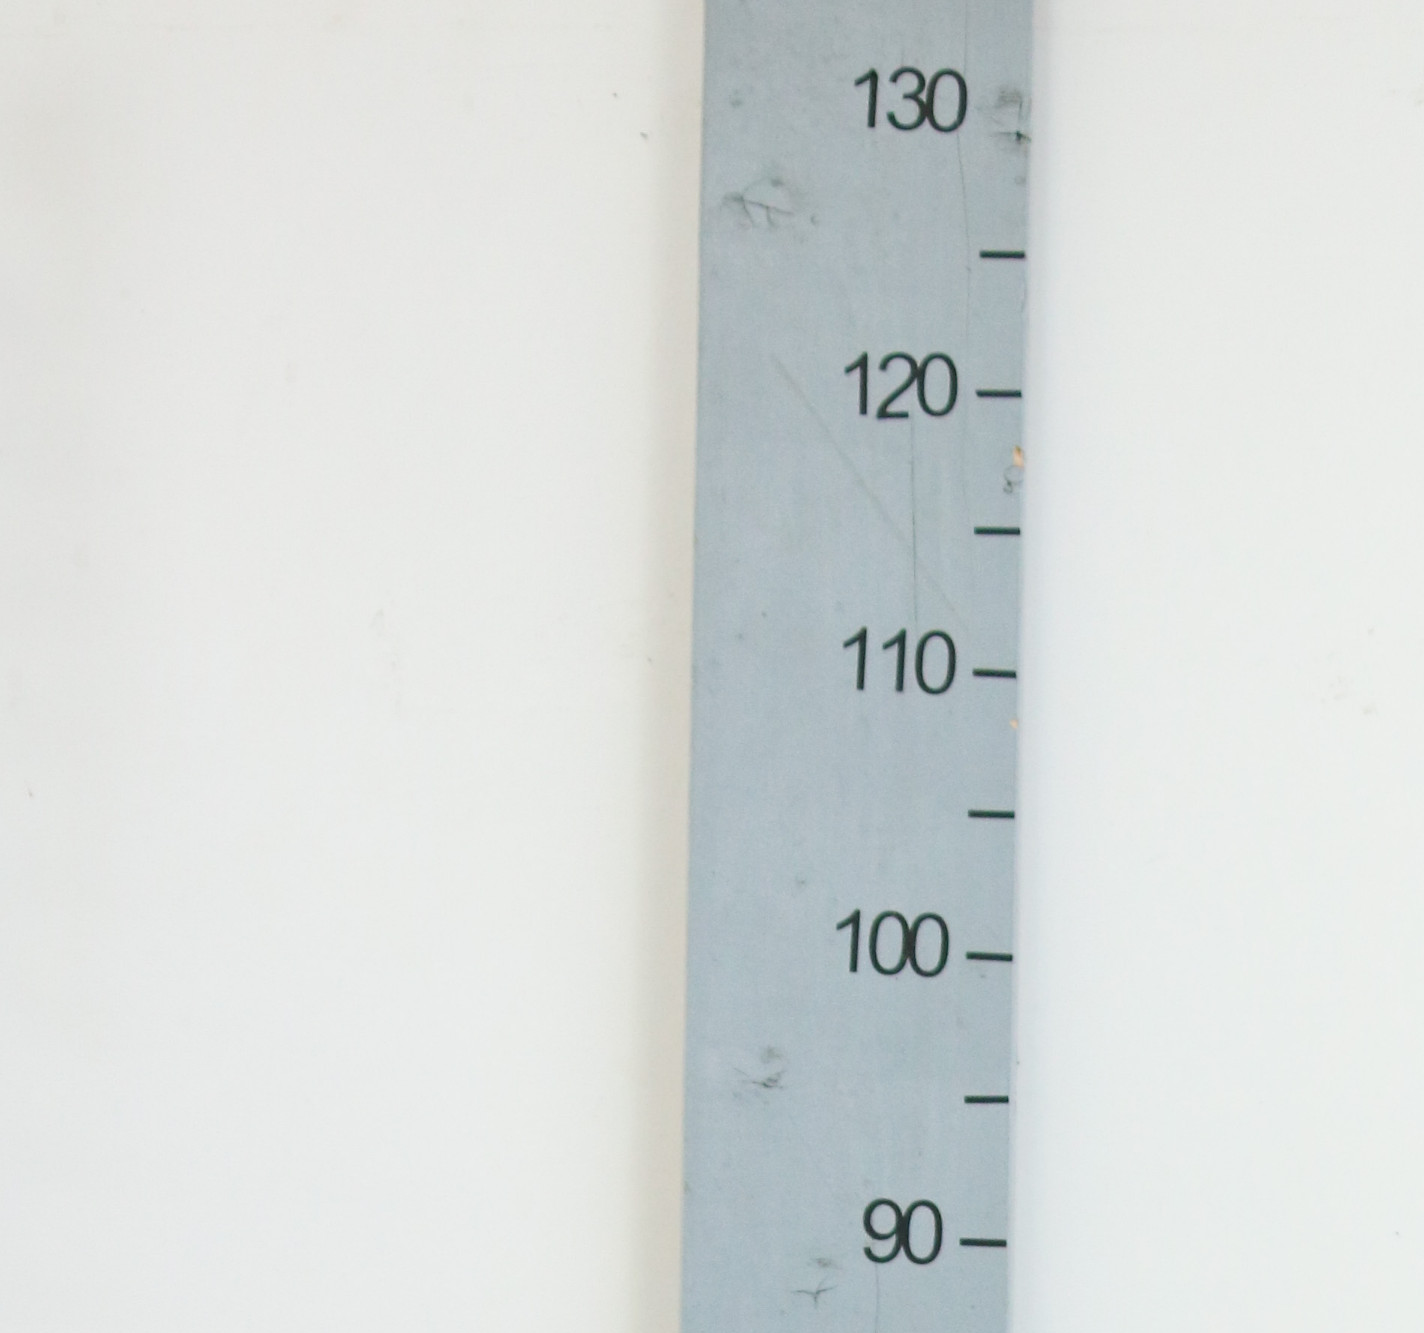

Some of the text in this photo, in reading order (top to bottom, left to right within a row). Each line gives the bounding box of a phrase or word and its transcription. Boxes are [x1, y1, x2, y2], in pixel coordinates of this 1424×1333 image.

[854, 66, 968, 132] 130
[844, 351, 958, 419] 120
[842, 627, 957, 695] 110
[836, 909, 949, 977] 100
[863, 1198, 943, 1265] 90
